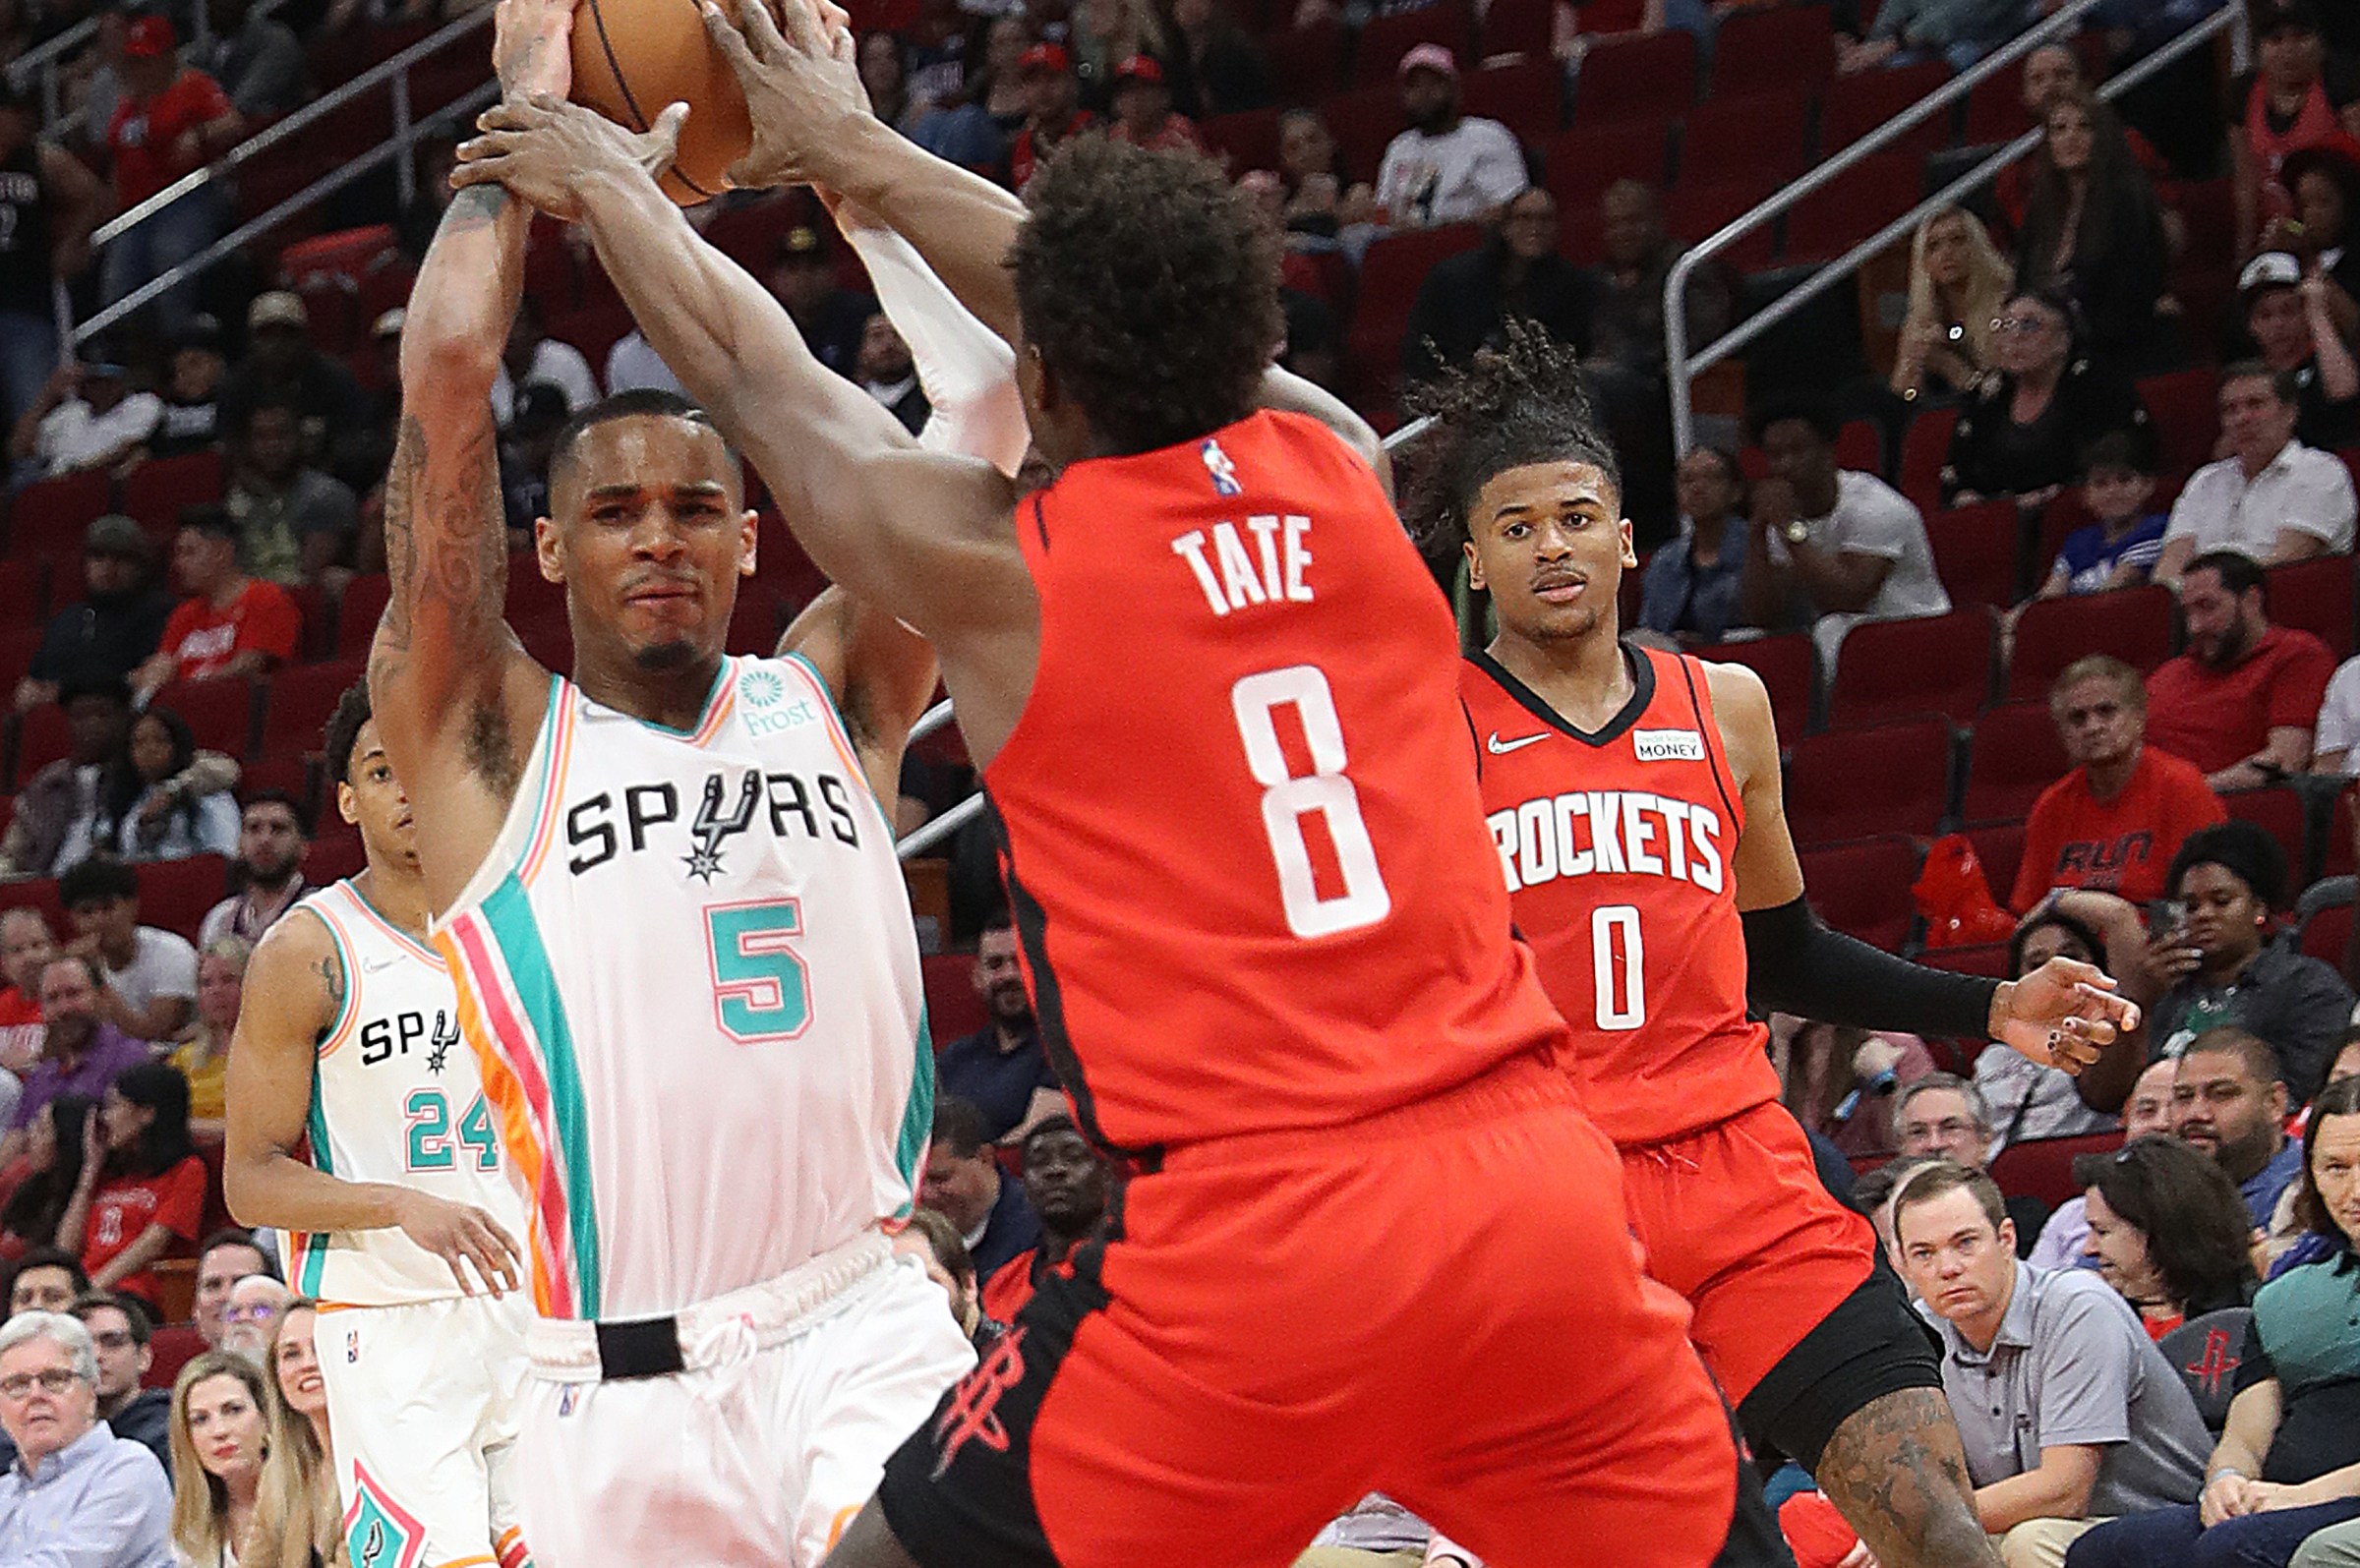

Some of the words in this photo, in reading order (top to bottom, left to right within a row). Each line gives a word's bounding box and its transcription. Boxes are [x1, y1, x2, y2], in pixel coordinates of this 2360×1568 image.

[1171, 514, 1315, 617] TATE
[742, 699, 817, 737] Frost
[1639, 743, 1697, 758] MONEY
[565, 768, 861, 886] SPURS
[1231, 663, 1391, 939] 8
[1484, 790, 1723, 896] ROCKETS
[2055, 828, 2154, 874] RUN
[702, 896, 814, 1045] 5
[1591, 905, 1646, 1031] 0
[360, 1009, 462, 1076] SPU
[404, 1087, 500, 1174] 24
